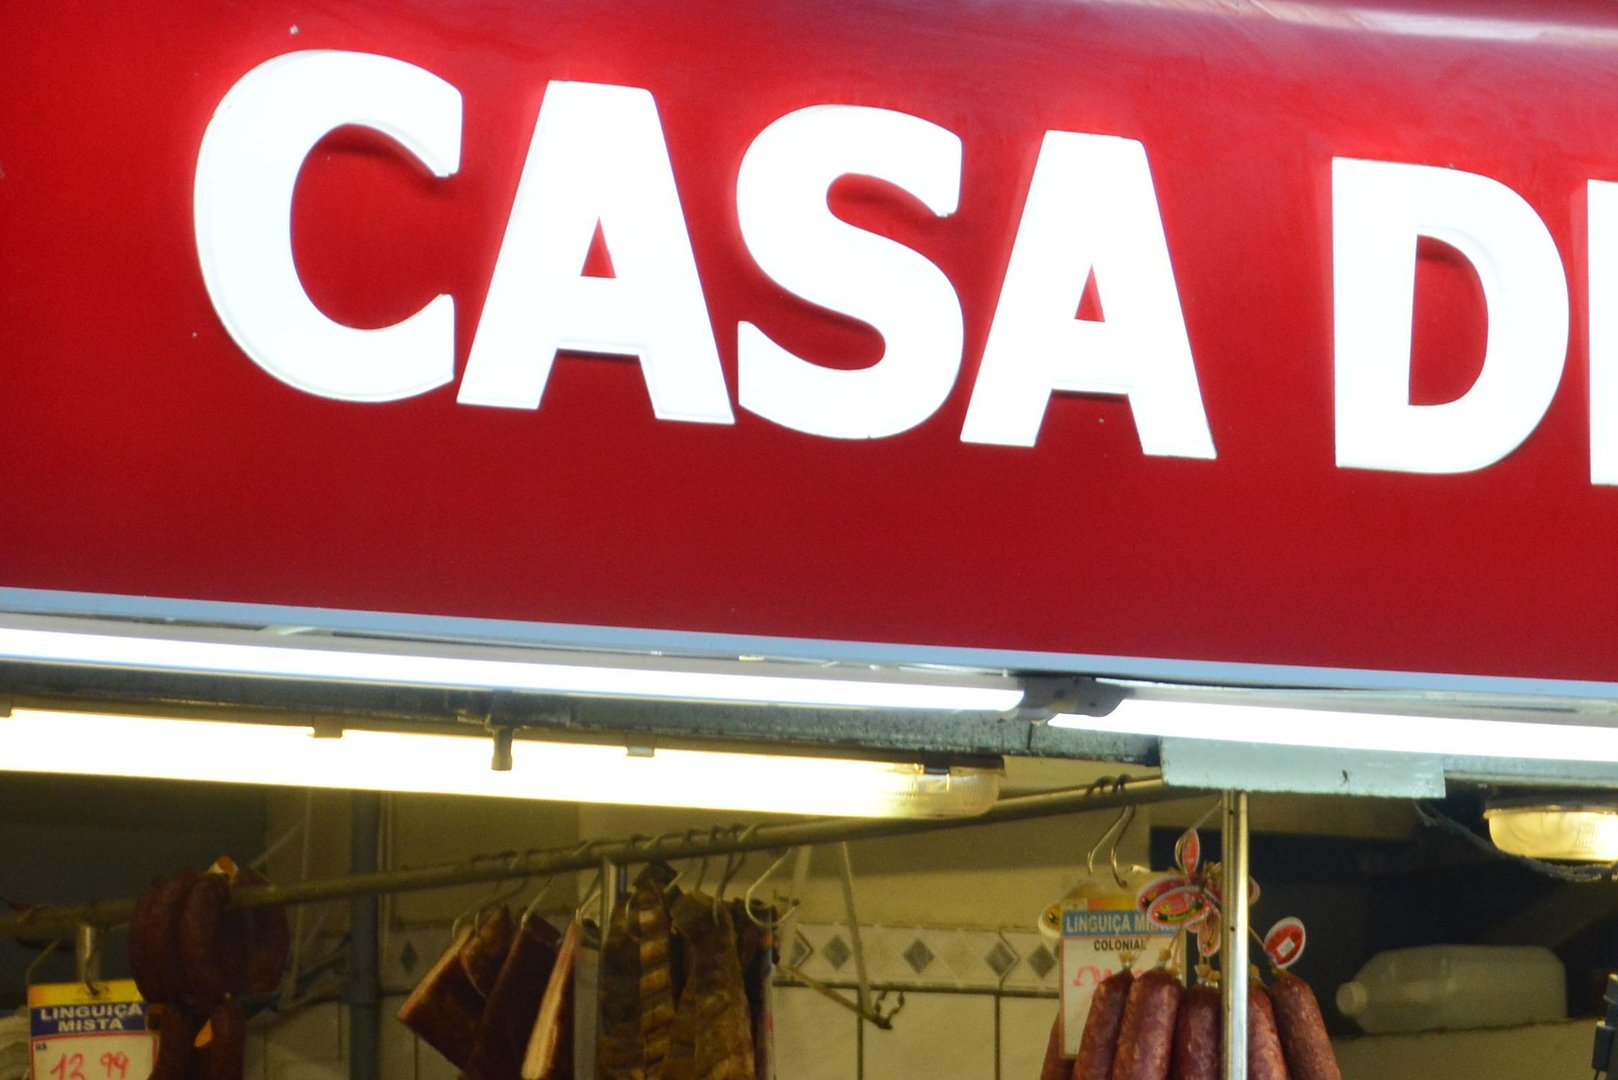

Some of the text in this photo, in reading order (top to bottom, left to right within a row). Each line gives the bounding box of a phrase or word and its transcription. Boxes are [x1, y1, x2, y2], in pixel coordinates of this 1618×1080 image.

[192, 49, 1219, 461] CASA
[1066, 912, 1131, 936] LINGUIÇA
[1093, 939, 1147, 952] COLONIAL
[40, 1003, 143, 1021] LINGUIÇA
[57, 1018, 123, 1033] MISTA
